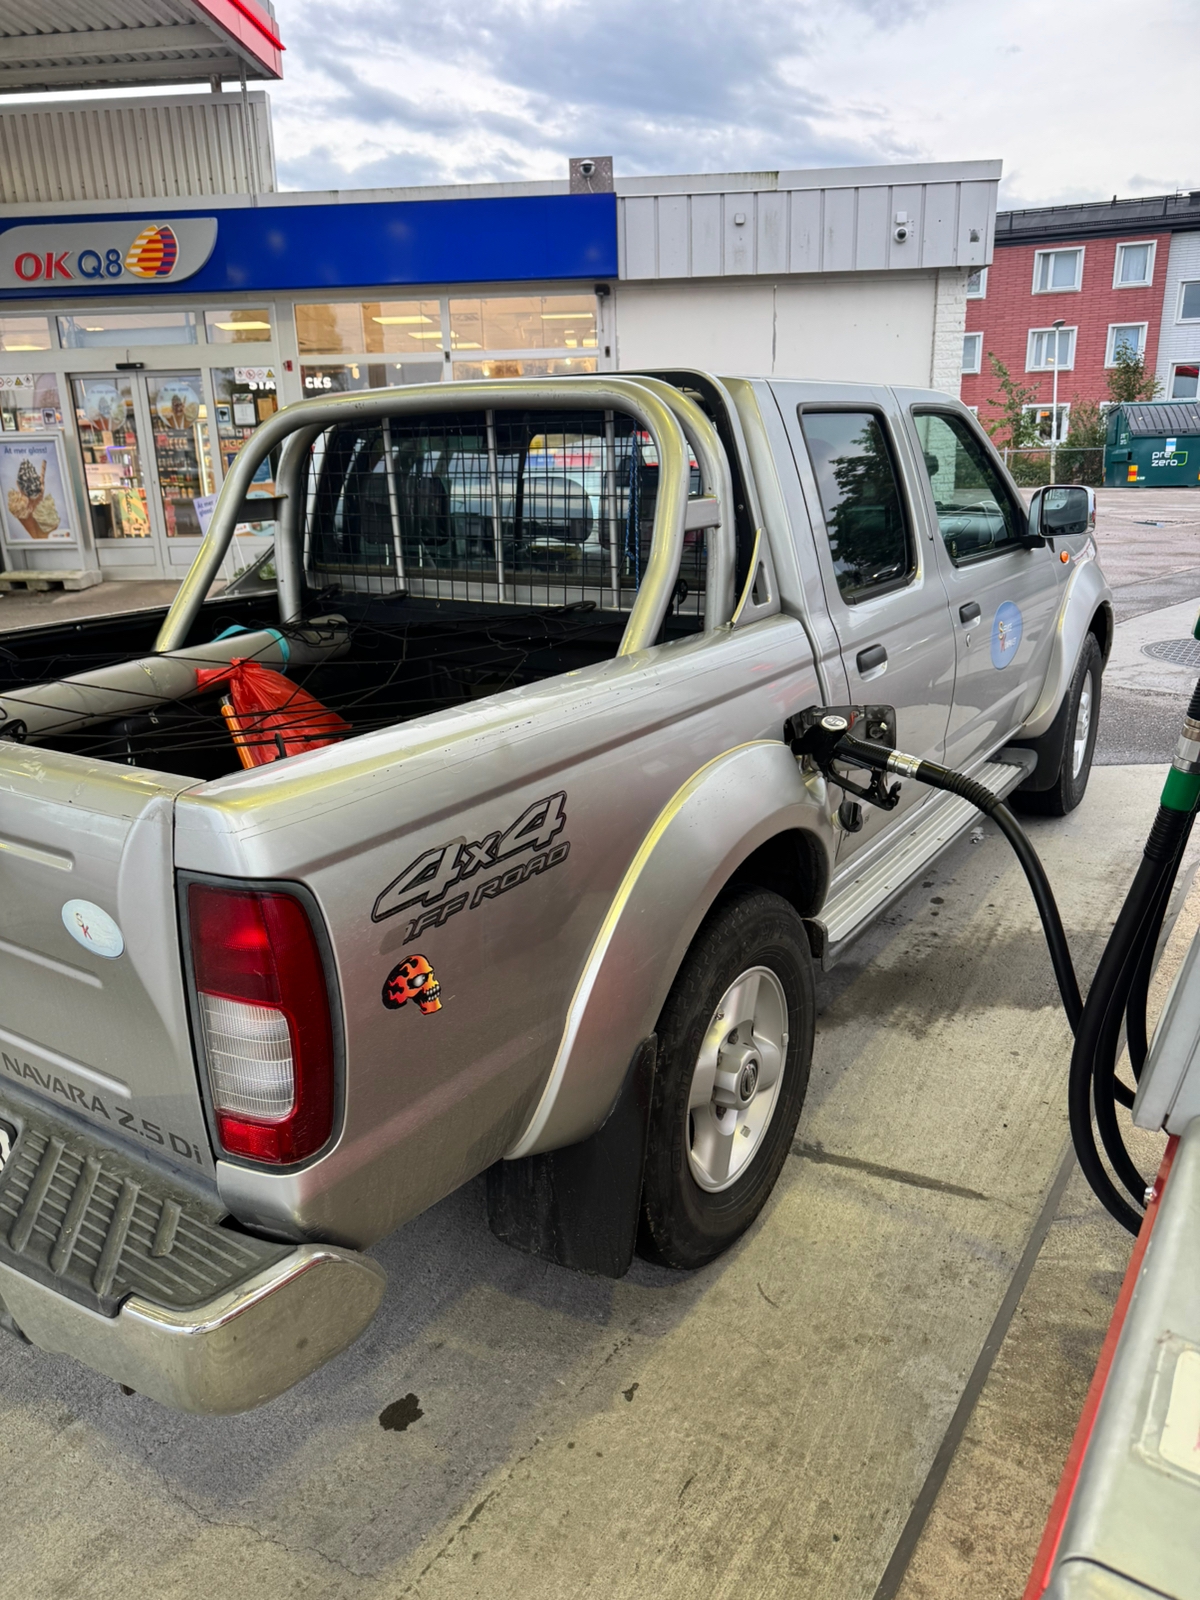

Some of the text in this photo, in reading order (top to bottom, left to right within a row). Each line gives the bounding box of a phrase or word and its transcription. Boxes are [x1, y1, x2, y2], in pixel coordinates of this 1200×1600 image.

[1152, 451, 1171, 460] pre
[370, 789, 568, 924] 4x4
[402, 840, 572, 946] FF ROAD
[1, 1051, 204, 1166] NAVARA 2.5 Di
